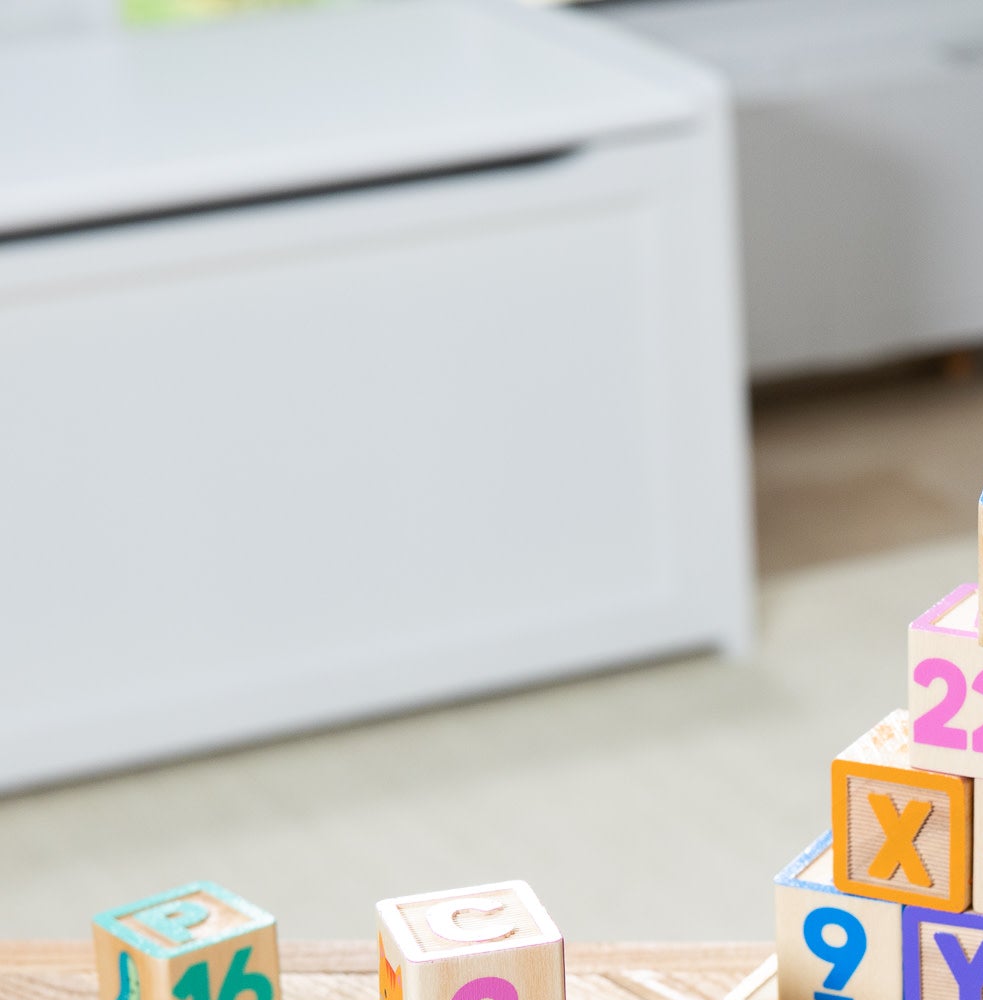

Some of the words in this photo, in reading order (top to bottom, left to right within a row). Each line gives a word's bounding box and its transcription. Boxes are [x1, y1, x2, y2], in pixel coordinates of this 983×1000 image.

[867, 793, 934, 888] X
[133, 901, 210, 943] P
[426, 897, 519, 942] C
